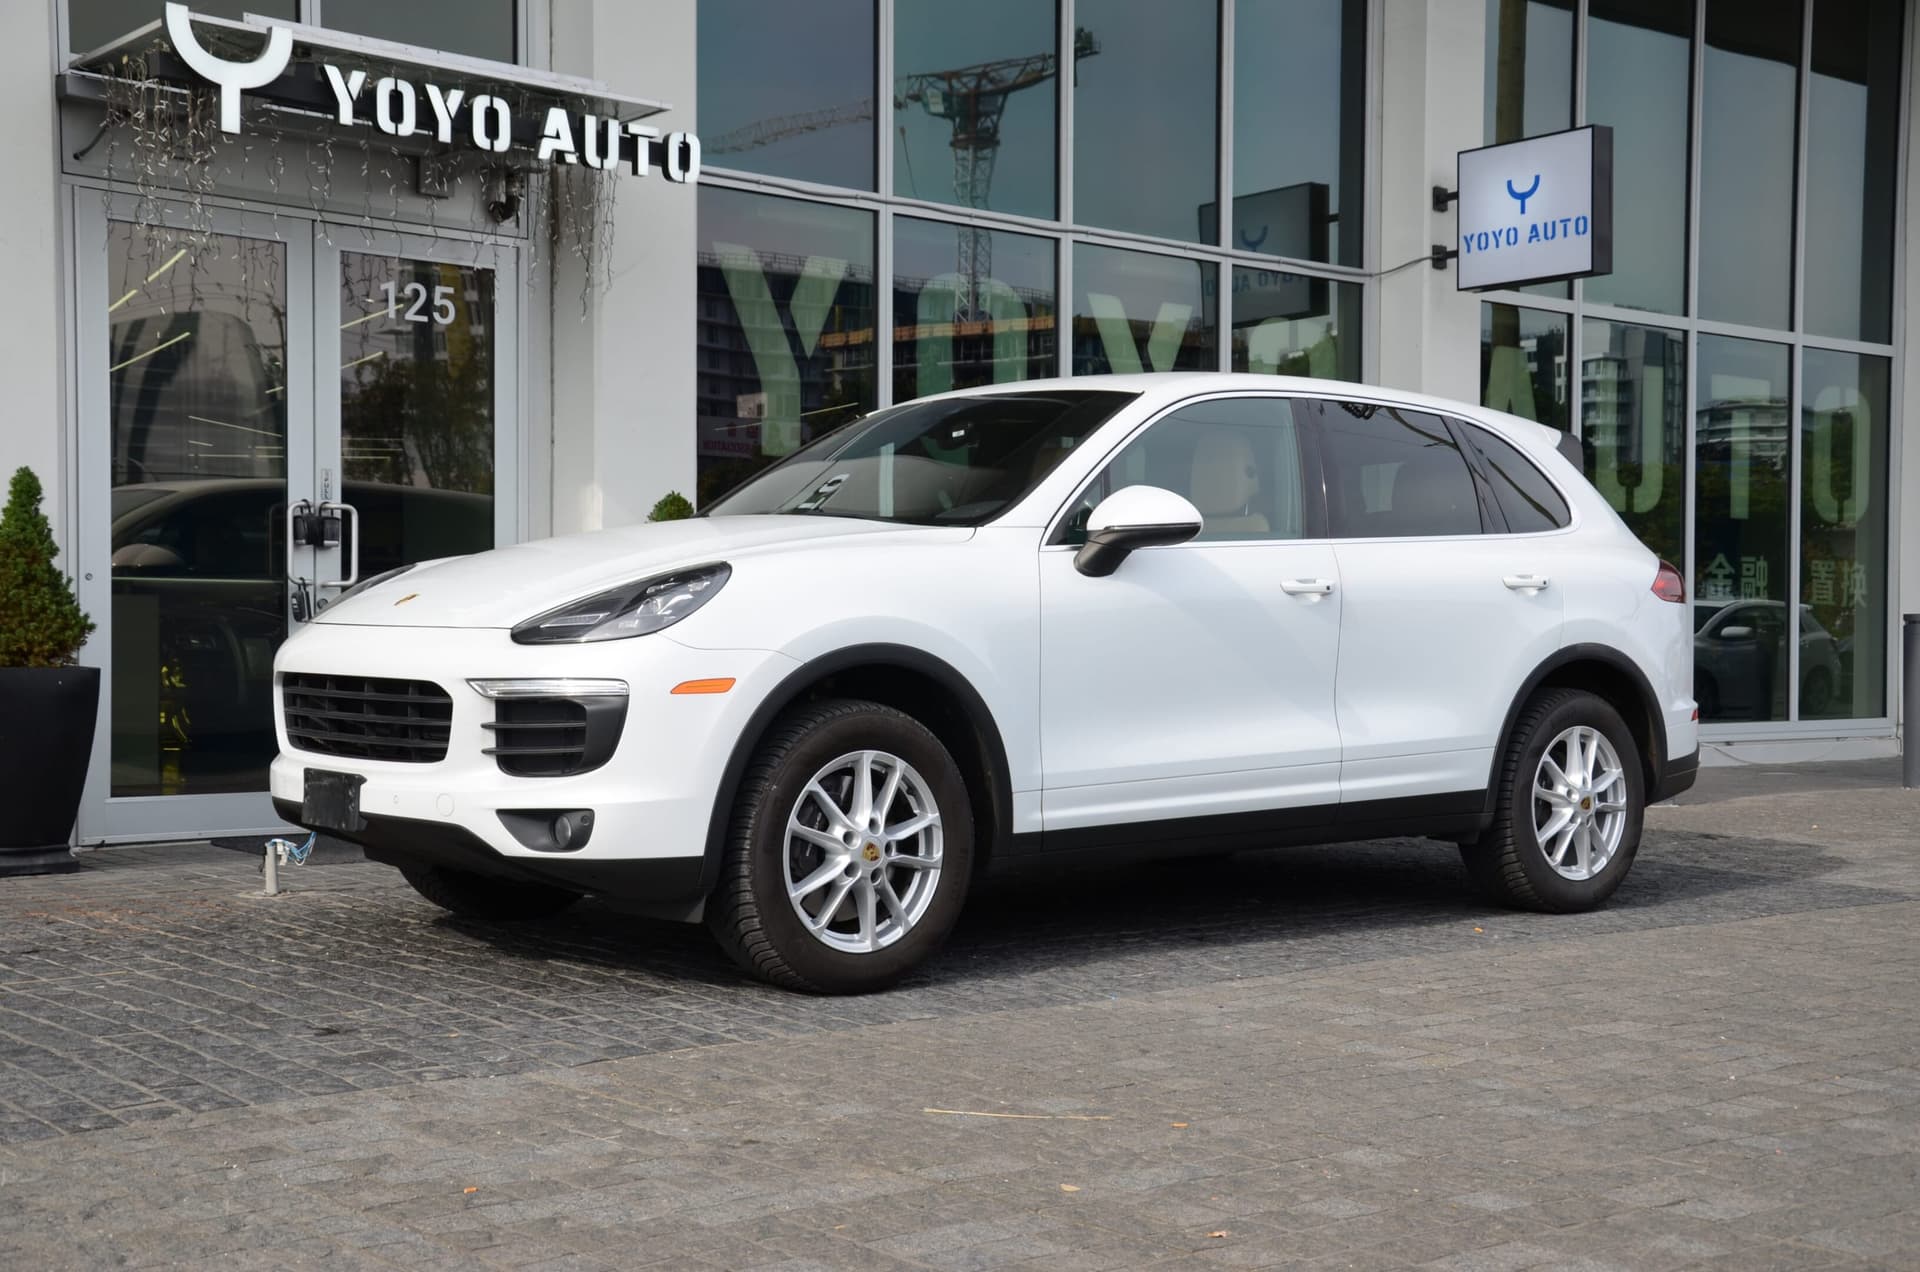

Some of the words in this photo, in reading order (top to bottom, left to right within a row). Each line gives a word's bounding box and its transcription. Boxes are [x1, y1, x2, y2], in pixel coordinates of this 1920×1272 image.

[322, 64, 512, 152] YOYO
[537, 107, 701, 184] AUTO
[1463, 227, 1518, 254] YOYO
[1528, 215, 1588, 243] AUTO
[380, 281, 456, 325] 125
[1705, 552, 1769, 601] 金融
